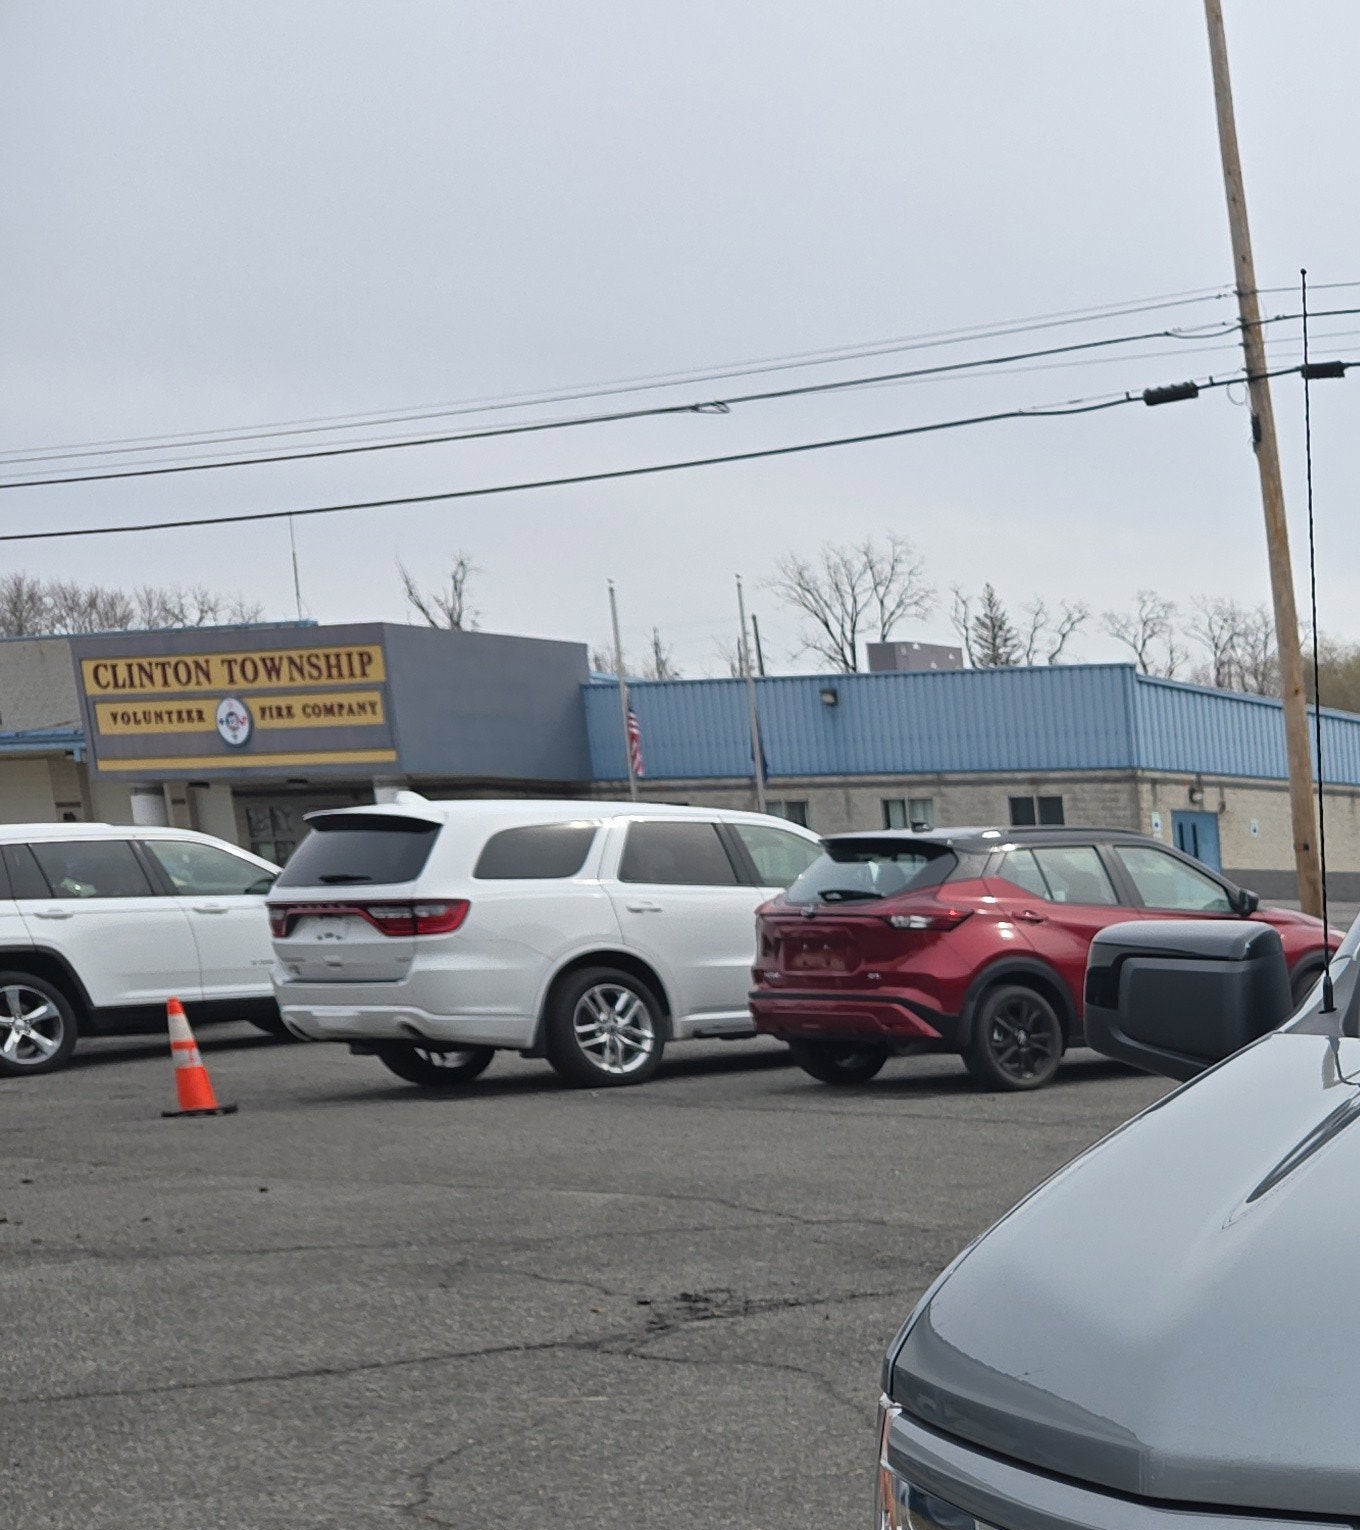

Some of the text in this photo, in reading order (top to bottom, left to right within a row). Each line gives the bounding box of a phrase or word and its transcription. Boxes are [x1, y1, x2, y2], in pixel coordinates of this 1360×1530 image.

[92, 650, 373, 690] CLINTON TOWNSHIP
[110, 700, 378, 725] VOLUNTEER FIRE COMPANY
